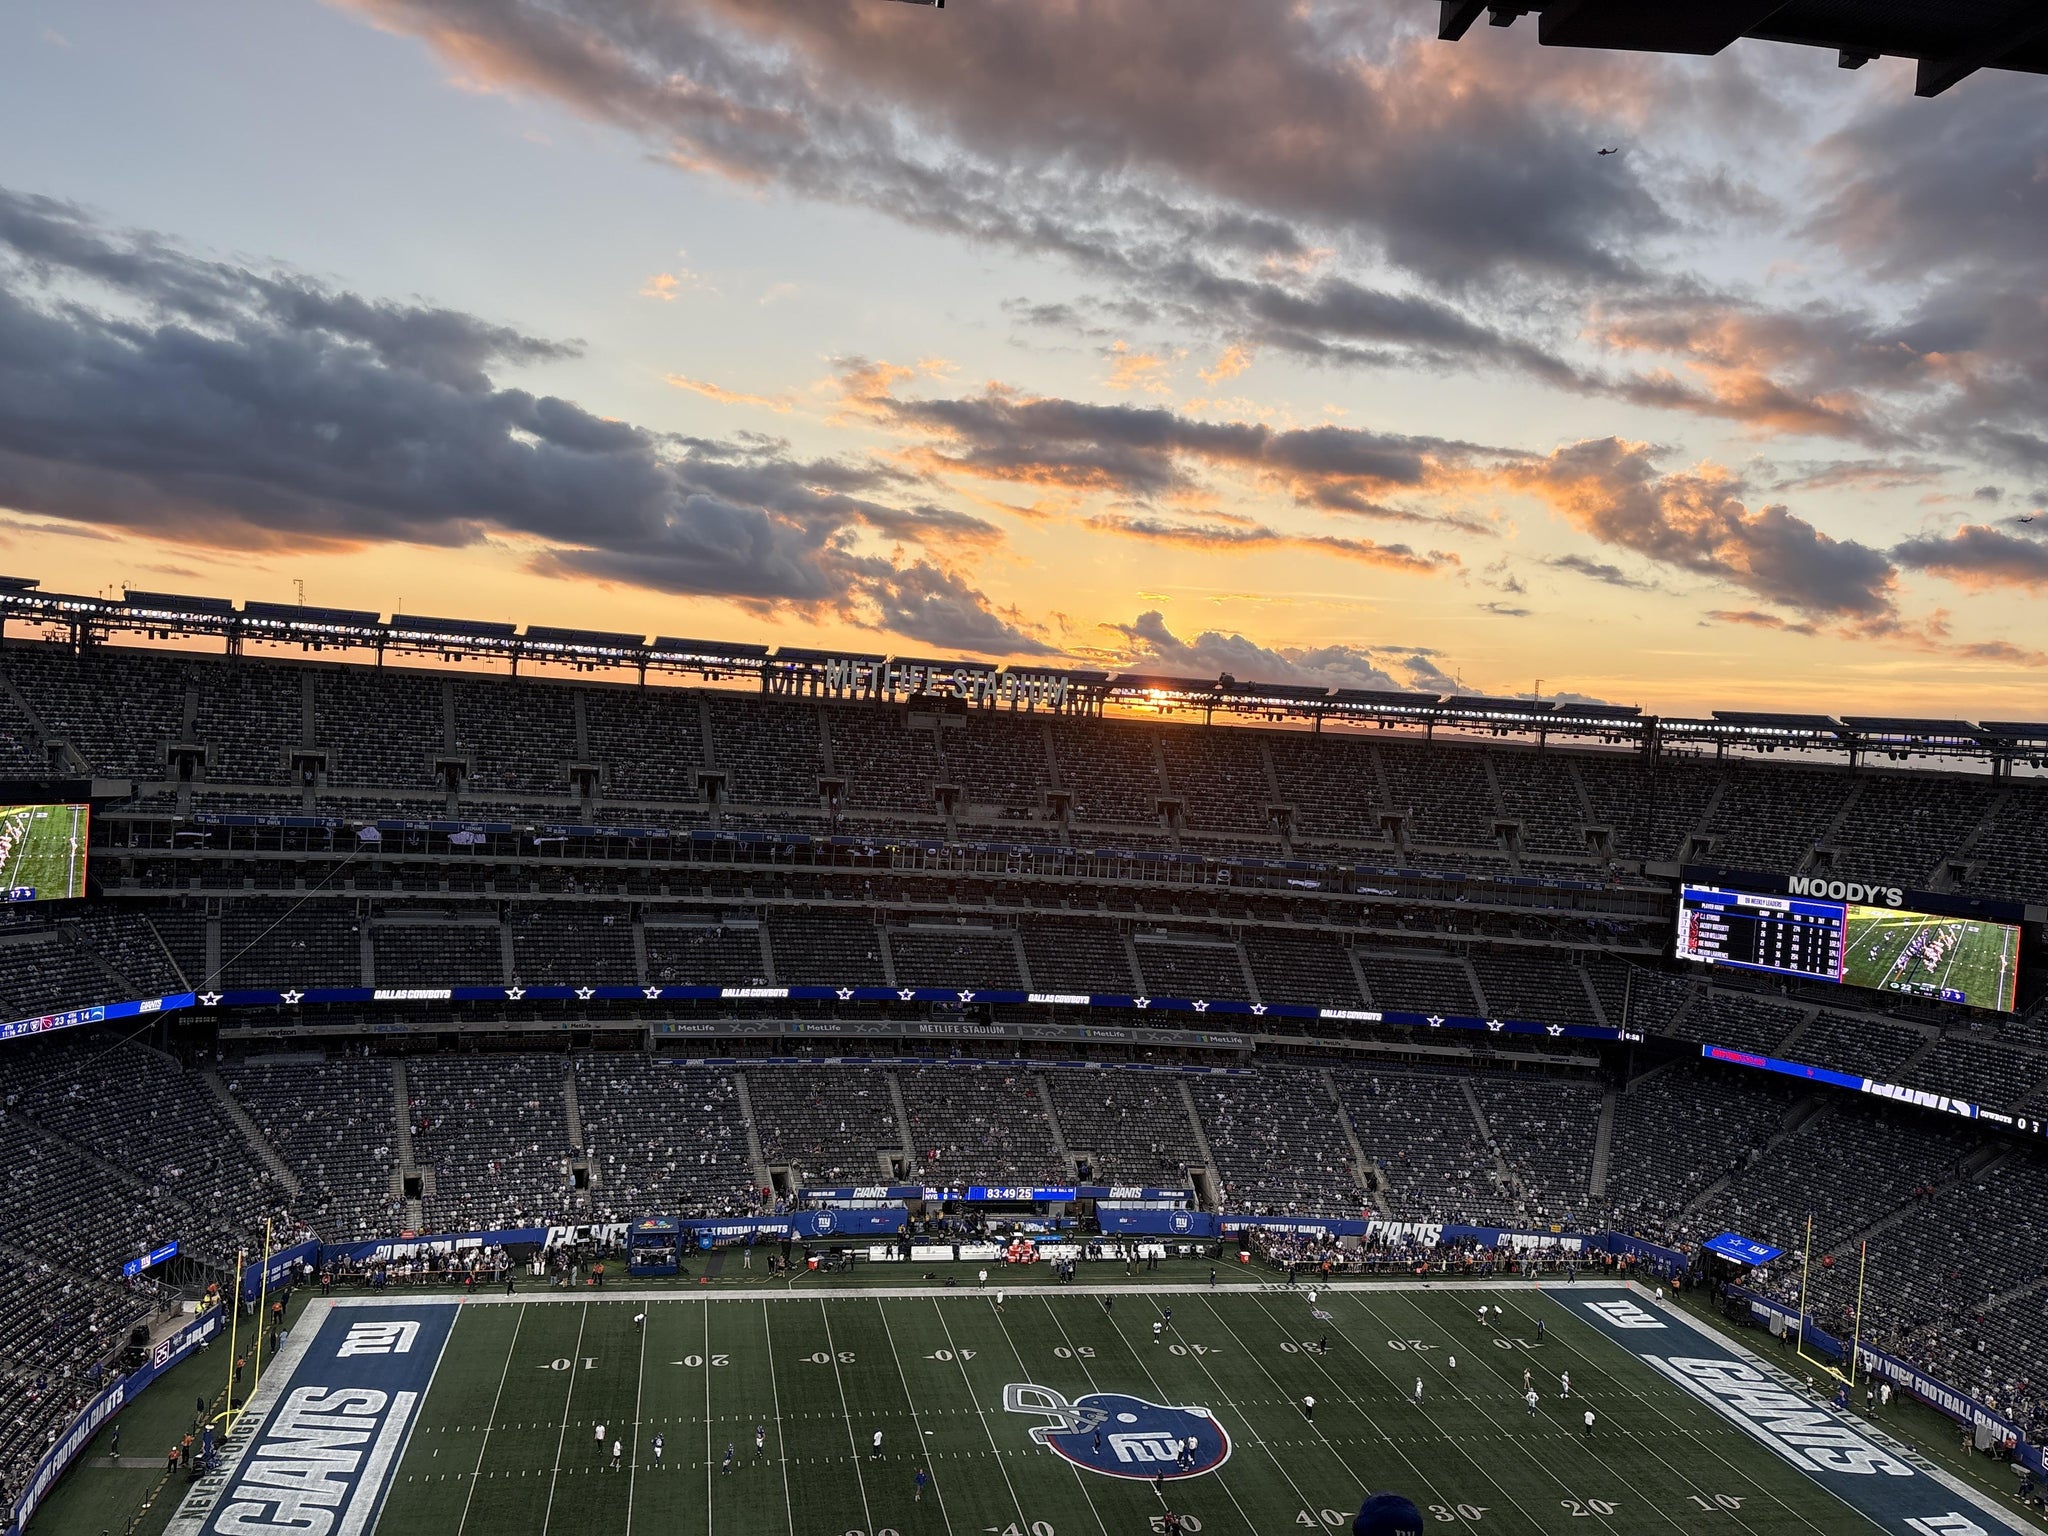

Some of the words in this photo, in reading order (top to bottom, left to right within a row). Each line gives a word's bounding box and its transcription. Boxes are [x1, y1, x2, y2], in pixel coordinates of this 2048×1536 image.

[826, 658, 942, 697] METLIFE
[952, 668, 1070, 706] STADIUM
[1788, 876, 1904, 907] MOODY'S
[721, 989, 750, 998] DALLAS
[750, 988, 789, 998] COWBOYS
[1900, 983, 1912, 991] 22
[373, 990, 407, 1000] DALLAS
[407, 989, 451, 999] COWBOYS
[1028, 993, 1055, 1003] DALLAS
[1055, 995, 1090, 1004] COWBOYS
[1941, 990, 1951, 998] 17
[139, 999, 162, 1012] GIANTS
[54, 1016, 64, 1026] 23
[80, 1011, 90, 1021] 14
[1320, 1009, 1347, 1019] DALLAS
[1346, 1010, 1382, 1021] COWBOYS
[17, 1023, 27, 1033] 27
[267, 1029, 297, 1037] verizon
[677, 1023, 715, 1033] MetLife
[806, 1023, 841, 1033] MetLife
[919, 1024, 960, 1033] METLIFE
[962, 1025, 1005, 1034] STADIUM
[1093, 1029, 1125, 1038] MetLife
[1210, 1035, 1243, 1044] MetLife
[1980, 1109, 2013, 1124] COWBOYS
[2018, 1117, 2026, 1129] 0
[2033, 1125, 2039, 1133] 3
[853, 1187, 889, 1198] GIANTS
[986, 1187, 1016, 1199] 83:49
[1018, 1188, 1031, 1198] 25
[1109, 1187, 1143, 1198] GIANTS
[717, 1225, 755, 1236] FOOTBALL
[757, 1224, 789, 1234] GIANTS
[1298, 1225, 1327, 1234] GIANTS
[1365, 1220, 1444, 1247] GIANTS
[542, 1223, 633, 1253] GIANTS
[1257, 1282, 1332, 1292] KICKOFF
[336, 1321, 421, 1358] ny
[1387, 1339, 1431, 1352] 20
[1492, 1337, 1538, 1350] 10
[1053, 1346, 1096, 1359] 50
[1169, 1343, 1209, 1356] 40
[1279, 1340, 1325, 1354] 30
[156, 1345, 168, 1364] 25
[684, 1353, 731, 1367] 20
[811, 1351, 856, 1365] 30
[935, 1348, 977, 1362] 40
[551, 1357, 599, 1372] 10
[1884, 1357, 1914, 1388] YORK
[1914, 1380, 1973, 1422] FOOTBALL
[1668, 1356, 1915, 1477] GIANTS
[51, 1416, 91, 1478] FOOTBALL
[90, 1383, 124, 1430] GIANTS
[1107, 1431, 1180, 1463] ny
[213, 1386, 388, 1536] GIANTS
[1560, 1498, 1615, 1518] 20
[1686, 1494, 1742, 1512] 10
[1295, 1507, 1346, 1528] 40
[1428, 1503, 1483, 1523] 30
[1001, 1520, 1056, 1536] 40
